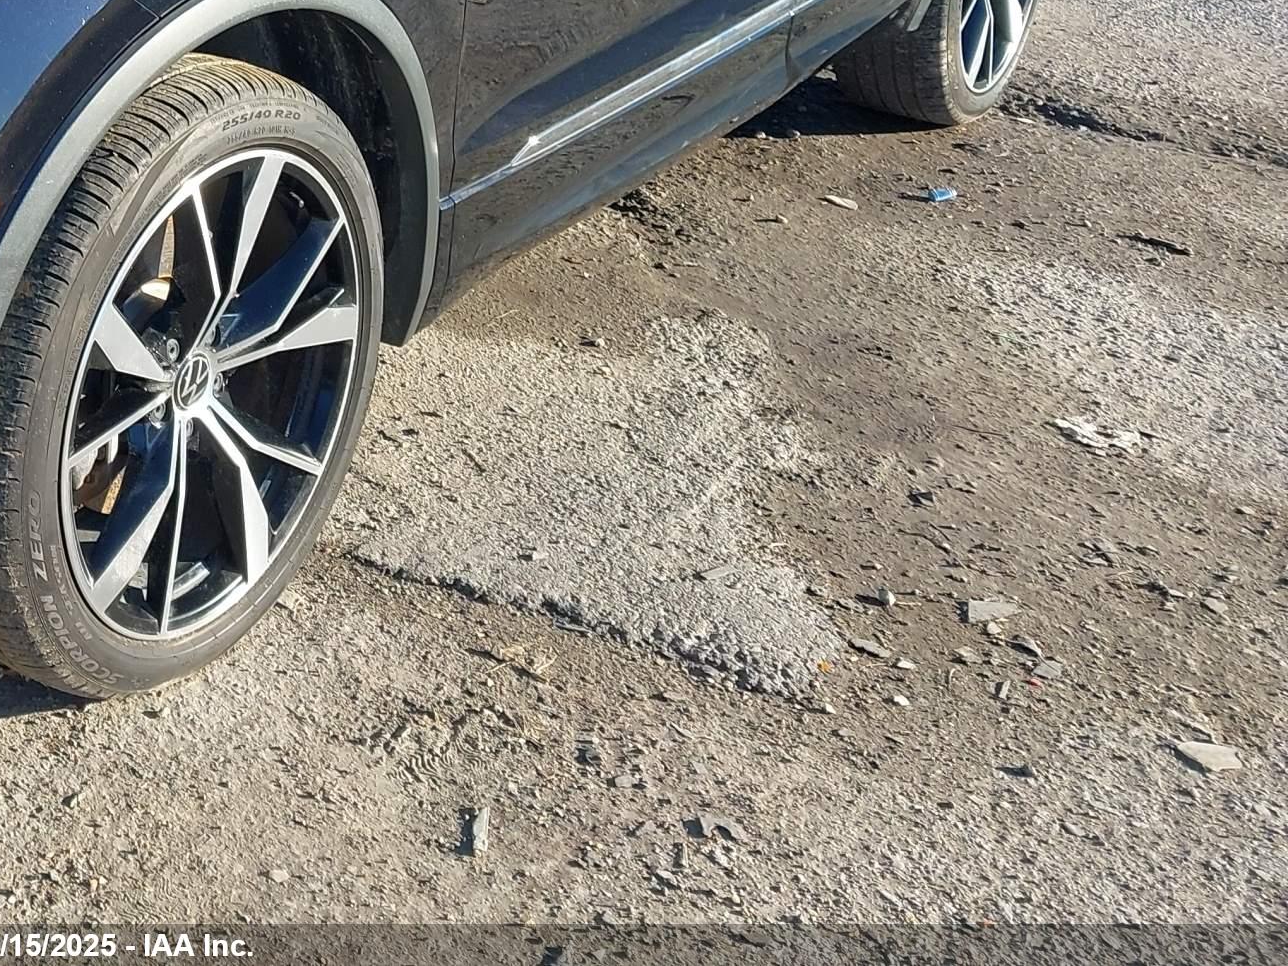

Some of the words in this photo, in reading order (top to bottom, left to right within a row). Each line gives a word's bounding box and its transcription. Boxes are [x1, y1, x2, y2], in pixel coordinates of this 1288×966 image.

[221, 109, 272, 132] 255/40
[274, 109, 301, 121] R20
[26, 490, 50, 583] ZERO
[40, 594, 125, 685] SCORPION
